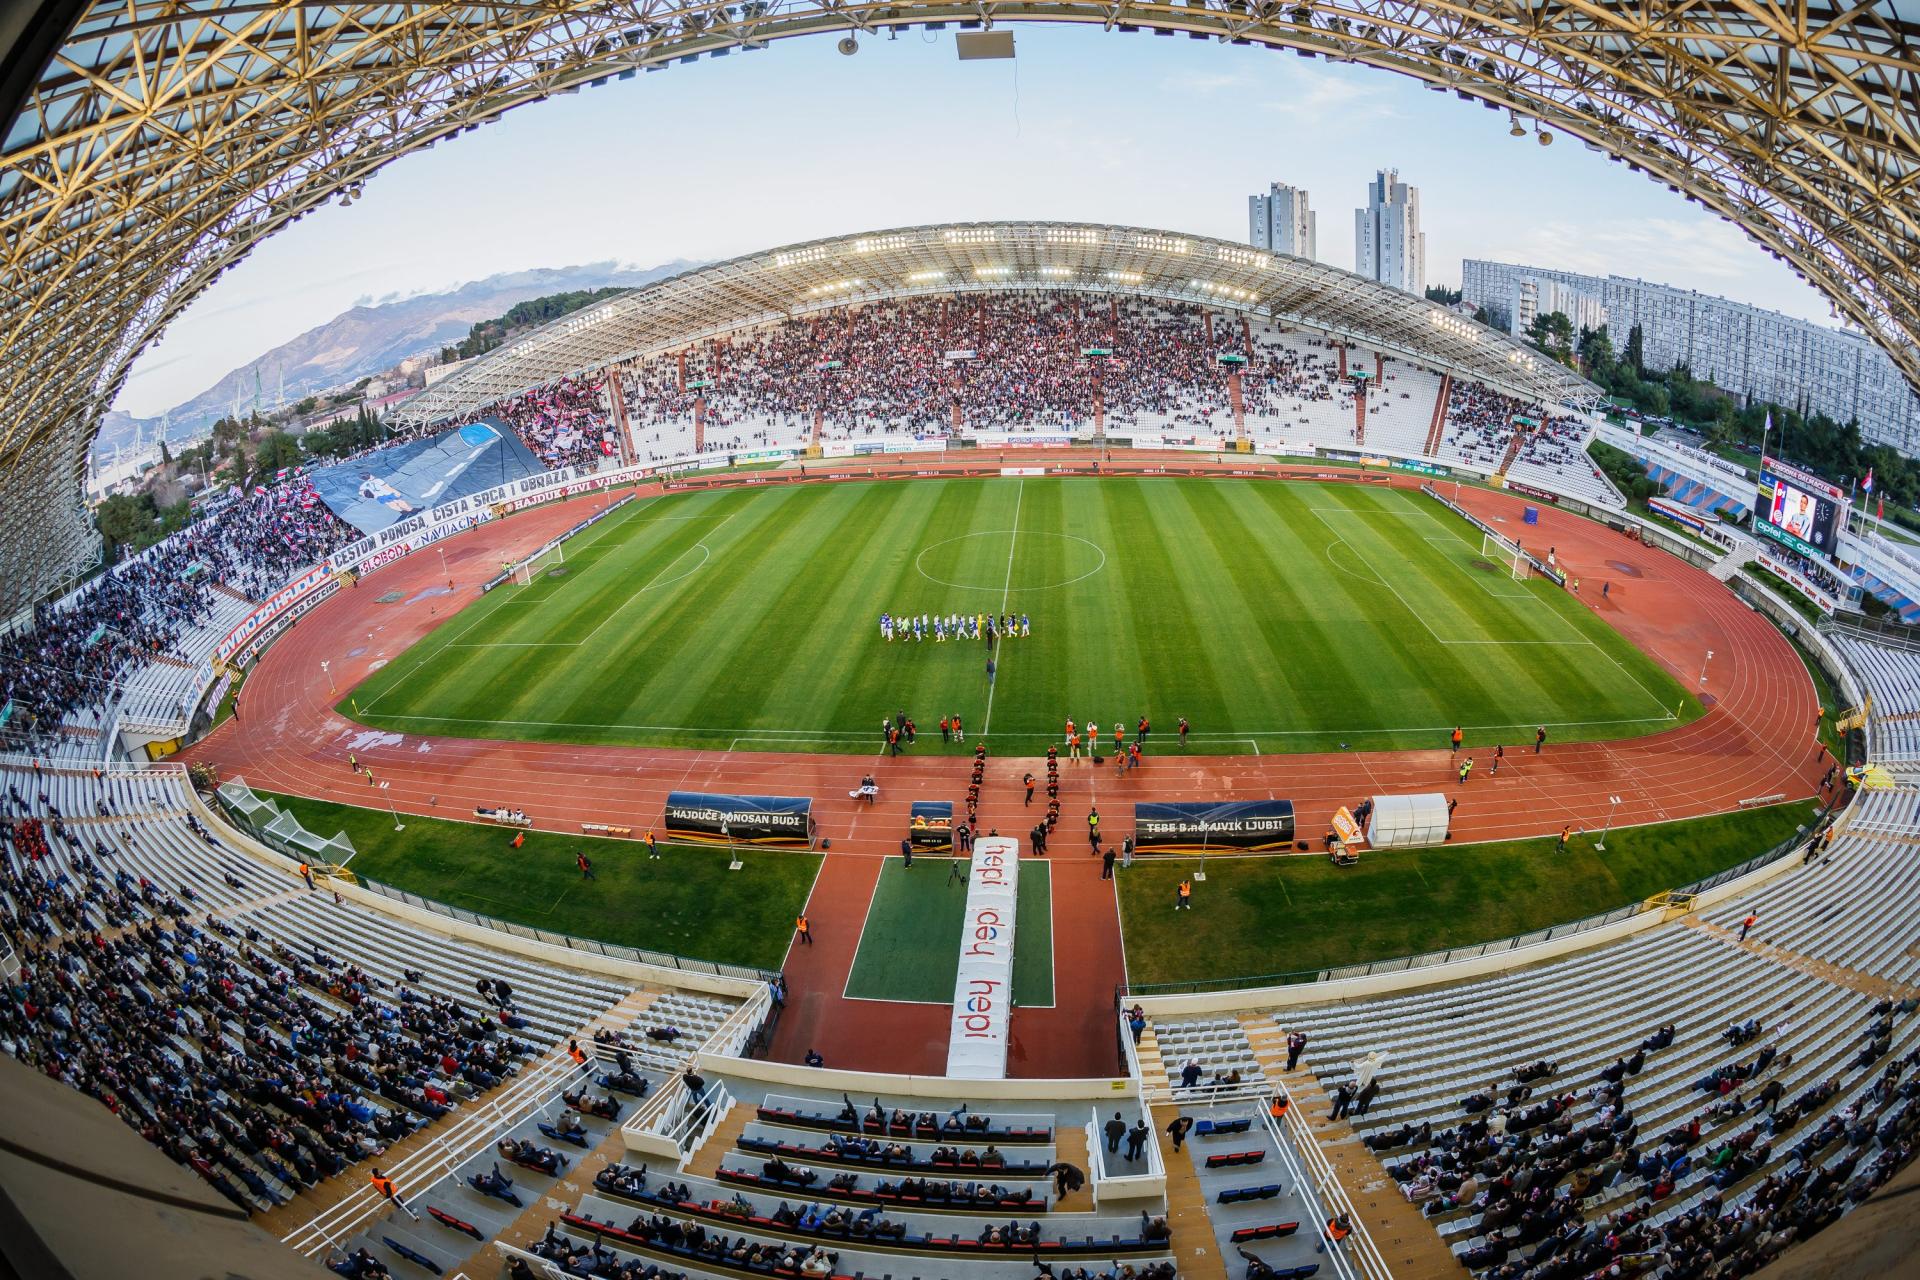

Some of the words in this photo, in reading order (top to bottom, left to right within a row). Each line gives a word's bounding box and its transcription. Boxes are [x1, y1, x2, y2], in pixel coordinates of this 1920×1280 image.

[1711, 457, 1735, 471] BANKA
[473, 487, 507, 507] SRCA
[511, 483, 516, 496] I
[519, 468, 570, 493] OBRAZA
[515, 490, 563, 510] HAJDUK
[673, 809, 719, 821] HAJDUČE
[720, 812, 770, 824] PONOSAN
[772, 815, 800, 826] BUDI
[1147, 823, 1176, 833] TEBE
[1246, 819, 1282, 831] LJUBI!
[976, 845, 1012, 885] hepi
[958, 980, 1001, 1039] hepi
